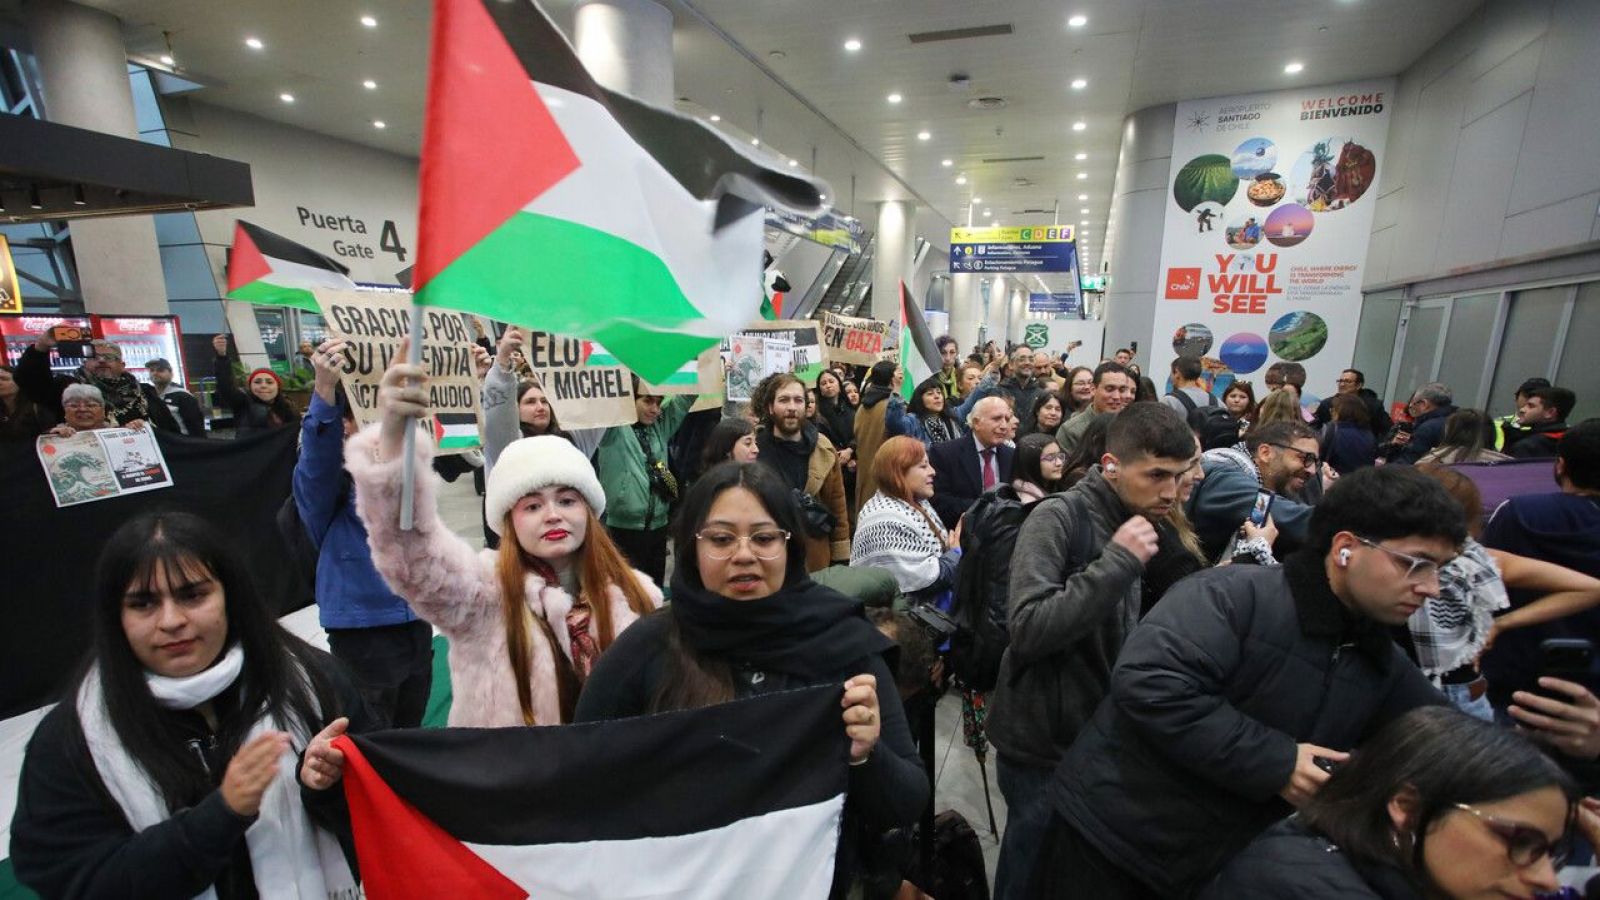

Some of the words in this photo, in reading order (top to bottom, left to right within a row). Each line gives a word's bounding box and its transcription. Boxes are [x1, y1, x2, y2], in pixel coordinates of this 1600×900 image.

[1219, 103, 1271, 115] AEROPUERTO
[1301, 92, 1385, 110] WELCOME
[1218, 112, 1261, 123] SANTIAGO
[1300, 104, 1383, 121] BIENVENIDO
[296, 206, 367, 235] Puerta
[333, 240, 375, 259] Gate
[380, 219, 407, 262] 4
[1207, 274, 1283, 294] WILL
[1212, 294, 1268, 314] SEE
[332, 305, 428, 339] GRACIA
[428, 312, 468, 342] POR
[824, 325, 846, 348] EN
[846, 328, 882, 354] GAZA
[342, 340, 374, 376] SU
[553, 369, 631, 401] MICHEL
[424, 385, 474, 409] AUDIO
